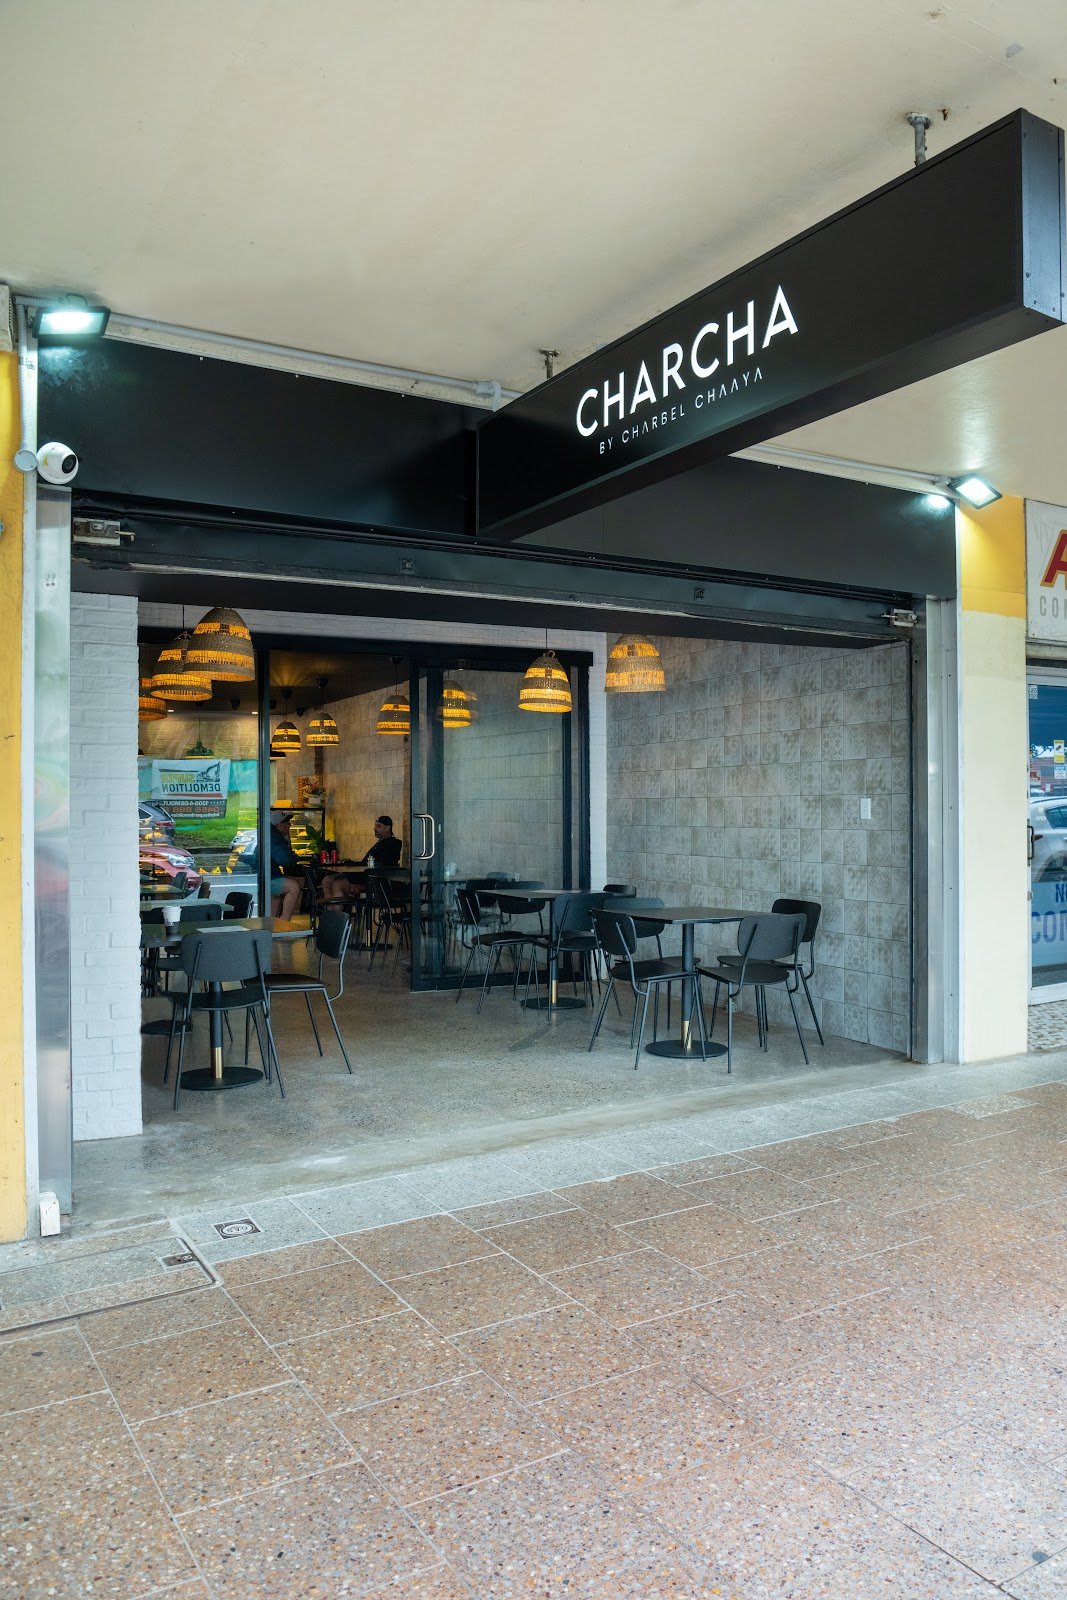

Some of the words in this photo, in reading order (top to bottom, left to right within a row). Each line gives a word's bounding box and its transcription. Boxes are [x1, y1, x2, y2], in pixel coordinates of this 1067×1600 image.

[576, 285, 799, 437] CHARCHA
[599, 436, 614, 455] BY
[621, 404, 685, 443] CHARBEL
